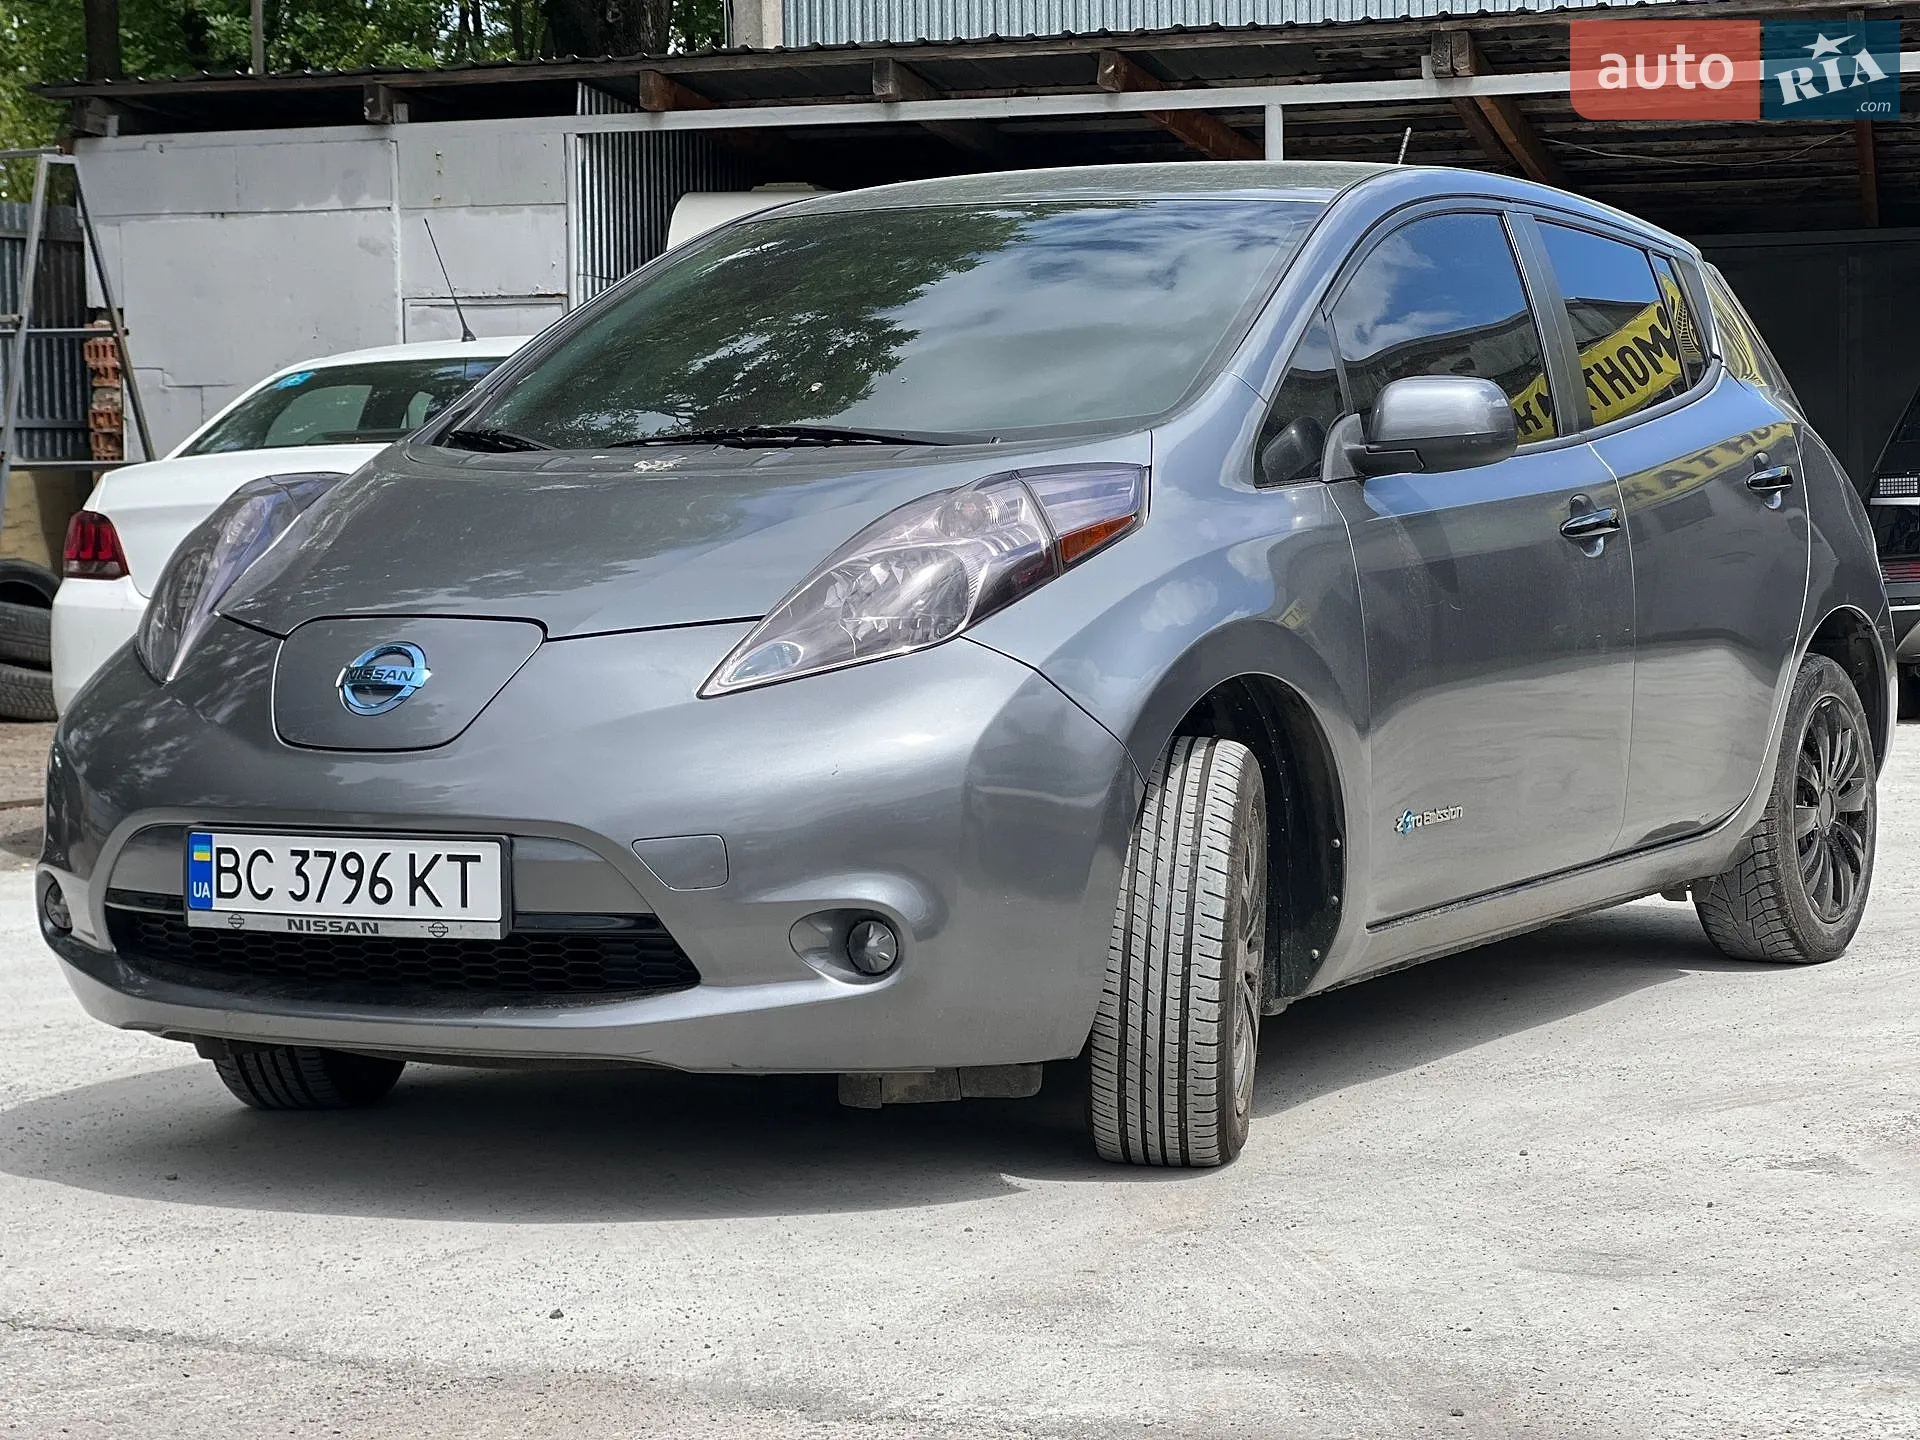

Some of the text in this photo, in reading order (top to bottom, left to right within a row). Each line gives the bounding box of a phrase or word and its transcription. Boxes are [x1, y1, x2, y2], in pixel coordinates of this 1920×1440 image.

[345, 667, 416, 682] NISSAN
[215, 846, 482, 908] BC 3796 KT
[193, 881, 211, 899] UA
[287, 918, 380, 935] NISSAN
